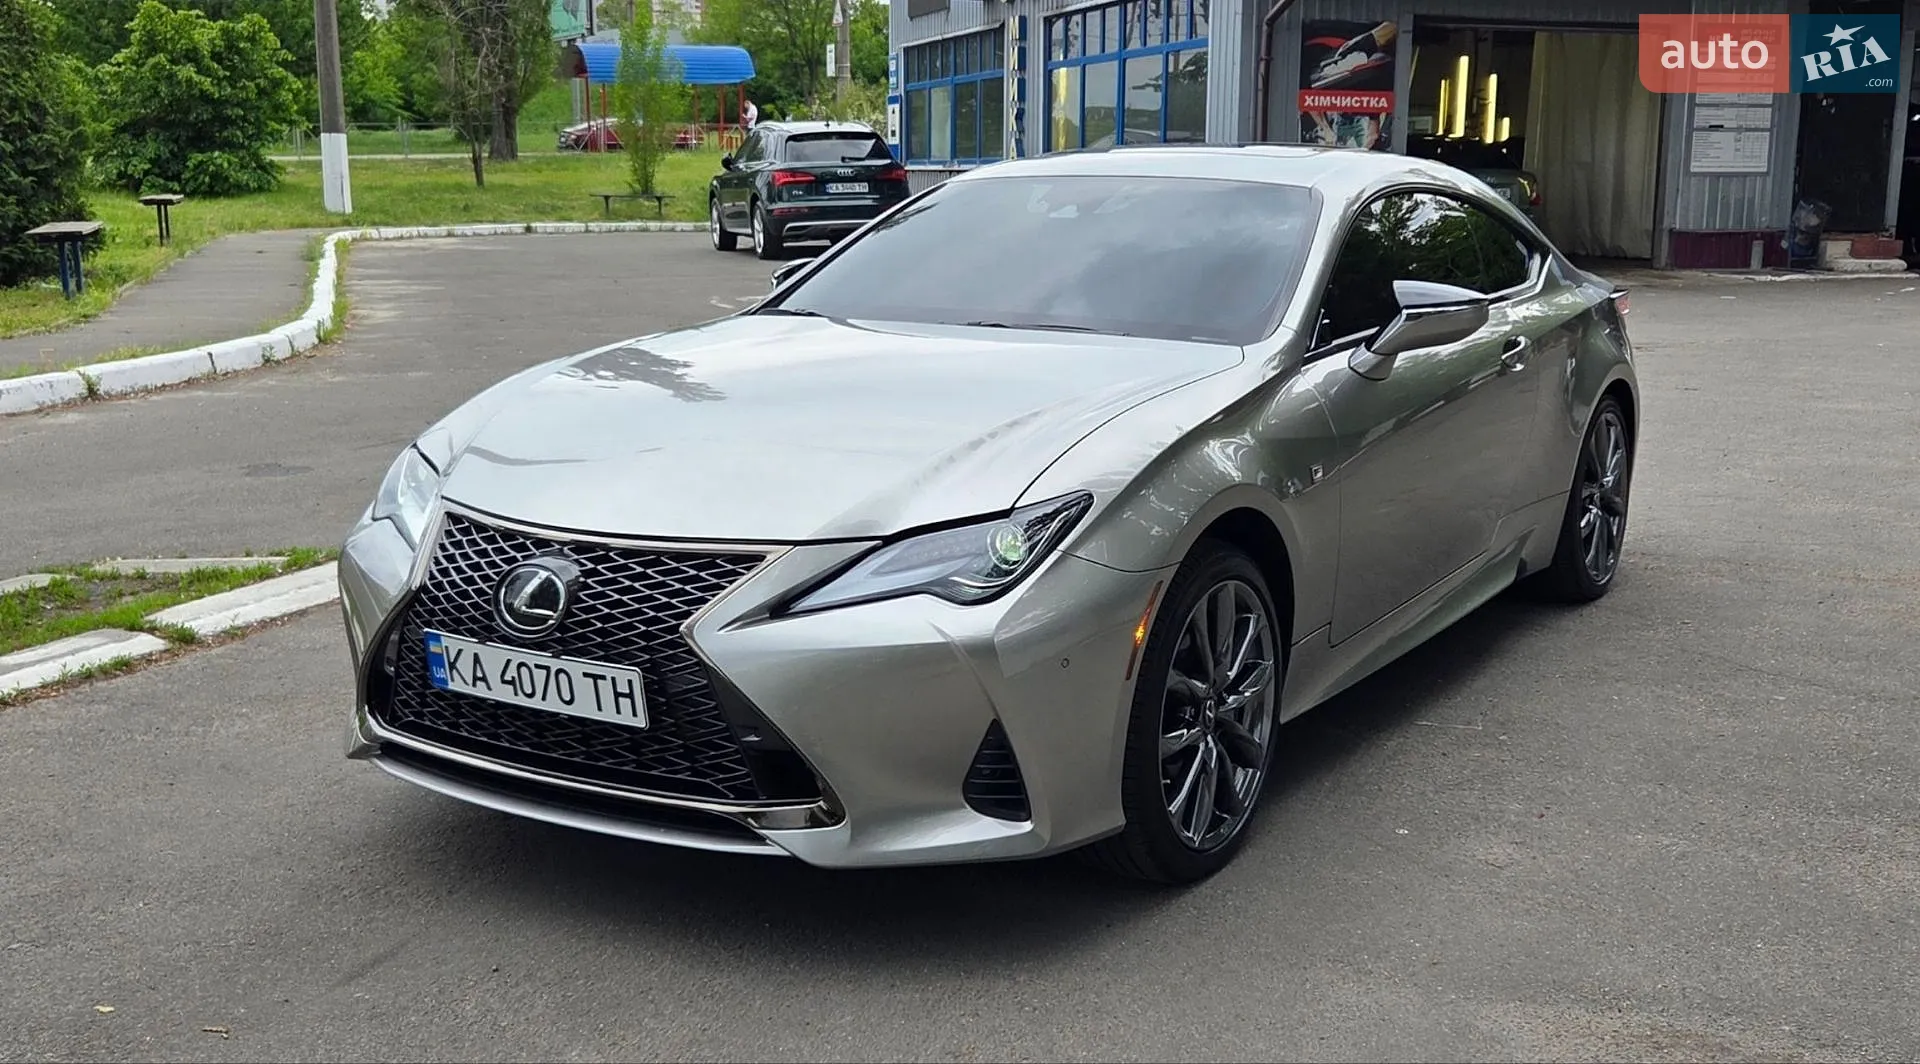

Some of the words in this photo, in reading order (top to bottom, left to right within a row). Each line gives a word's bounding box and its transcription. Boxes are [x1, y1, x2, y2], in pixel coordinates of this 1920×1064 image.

[1304, 95, 1388, 108] ХІМЧИСТКА
[433, 666, 447, 680] UA
[445, 645, 492, 691] KA
[500, 658, 575, 706] 4070
[582, 671, 638, 718] TH
